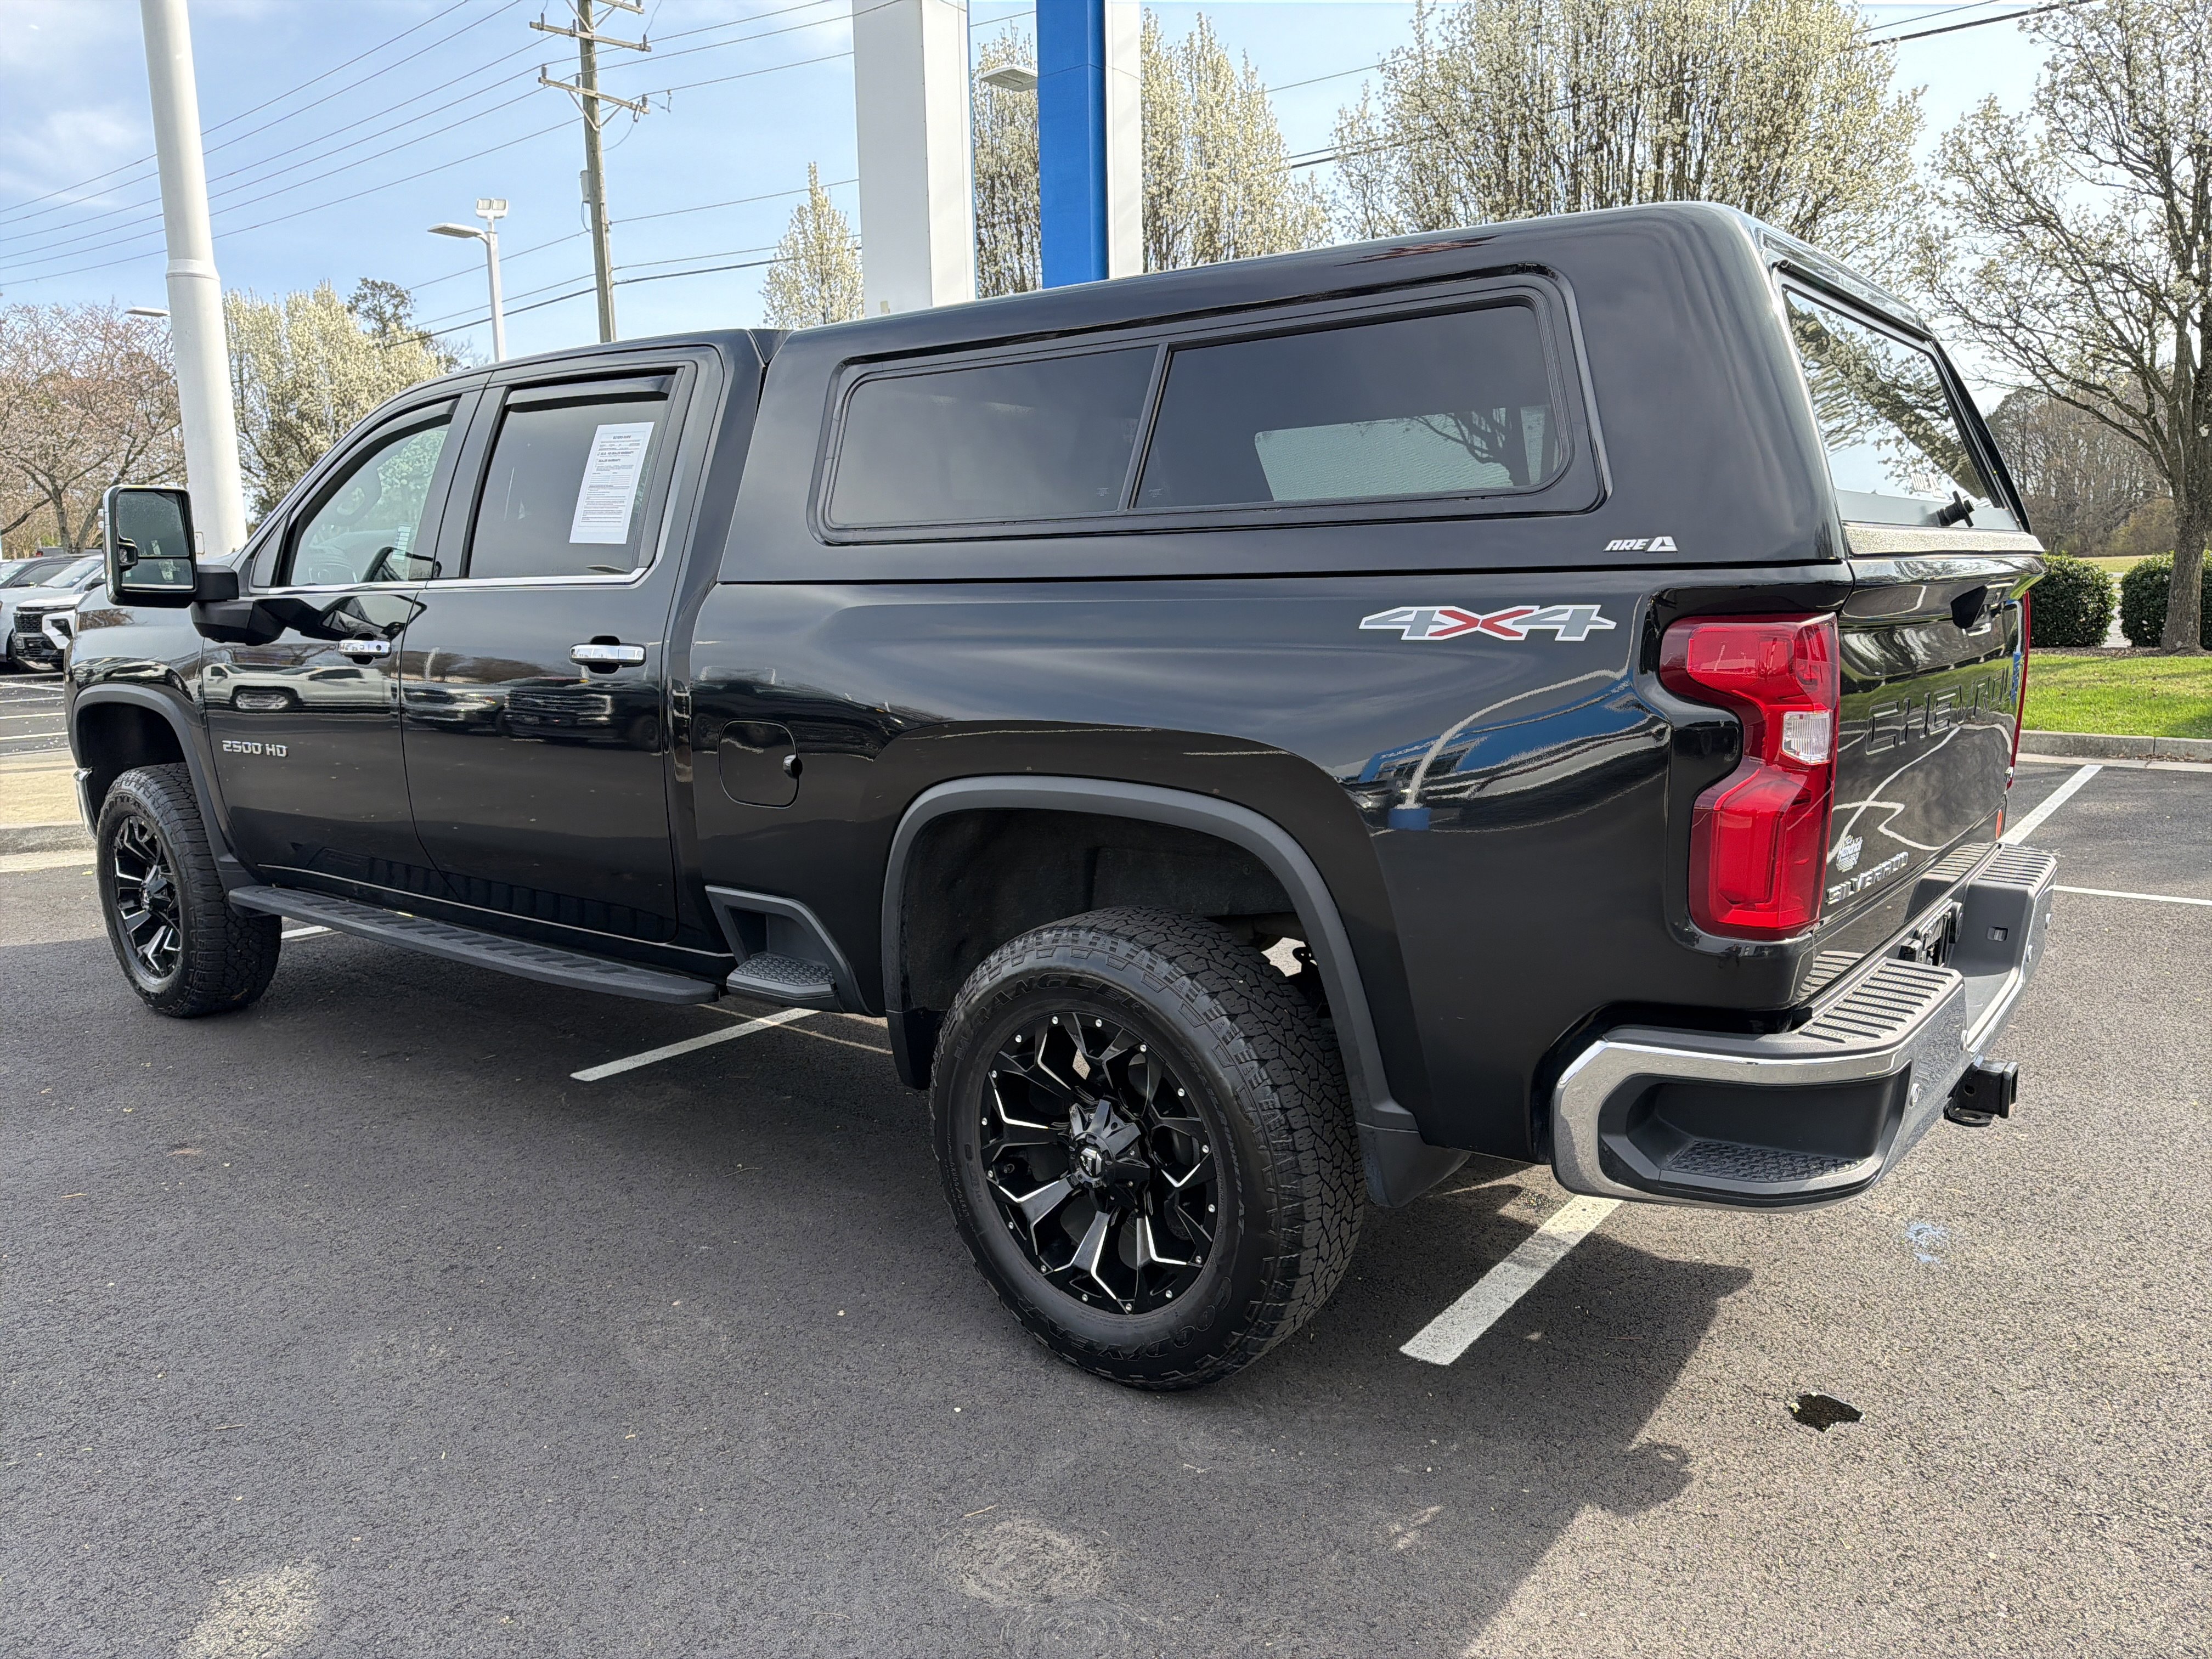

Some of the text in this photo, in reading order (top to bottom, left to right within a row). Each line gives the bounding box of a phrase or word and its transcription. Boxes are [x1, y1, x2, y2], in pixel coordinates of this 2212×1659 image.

[222, 740, 288, 758] 2500 HD
[1825, 851, 1909, 906] SILVERADO
[954, 971, 1150, 1061] WRANGLER
[1018, 1276, 1232, 1362] GOODYEAR
